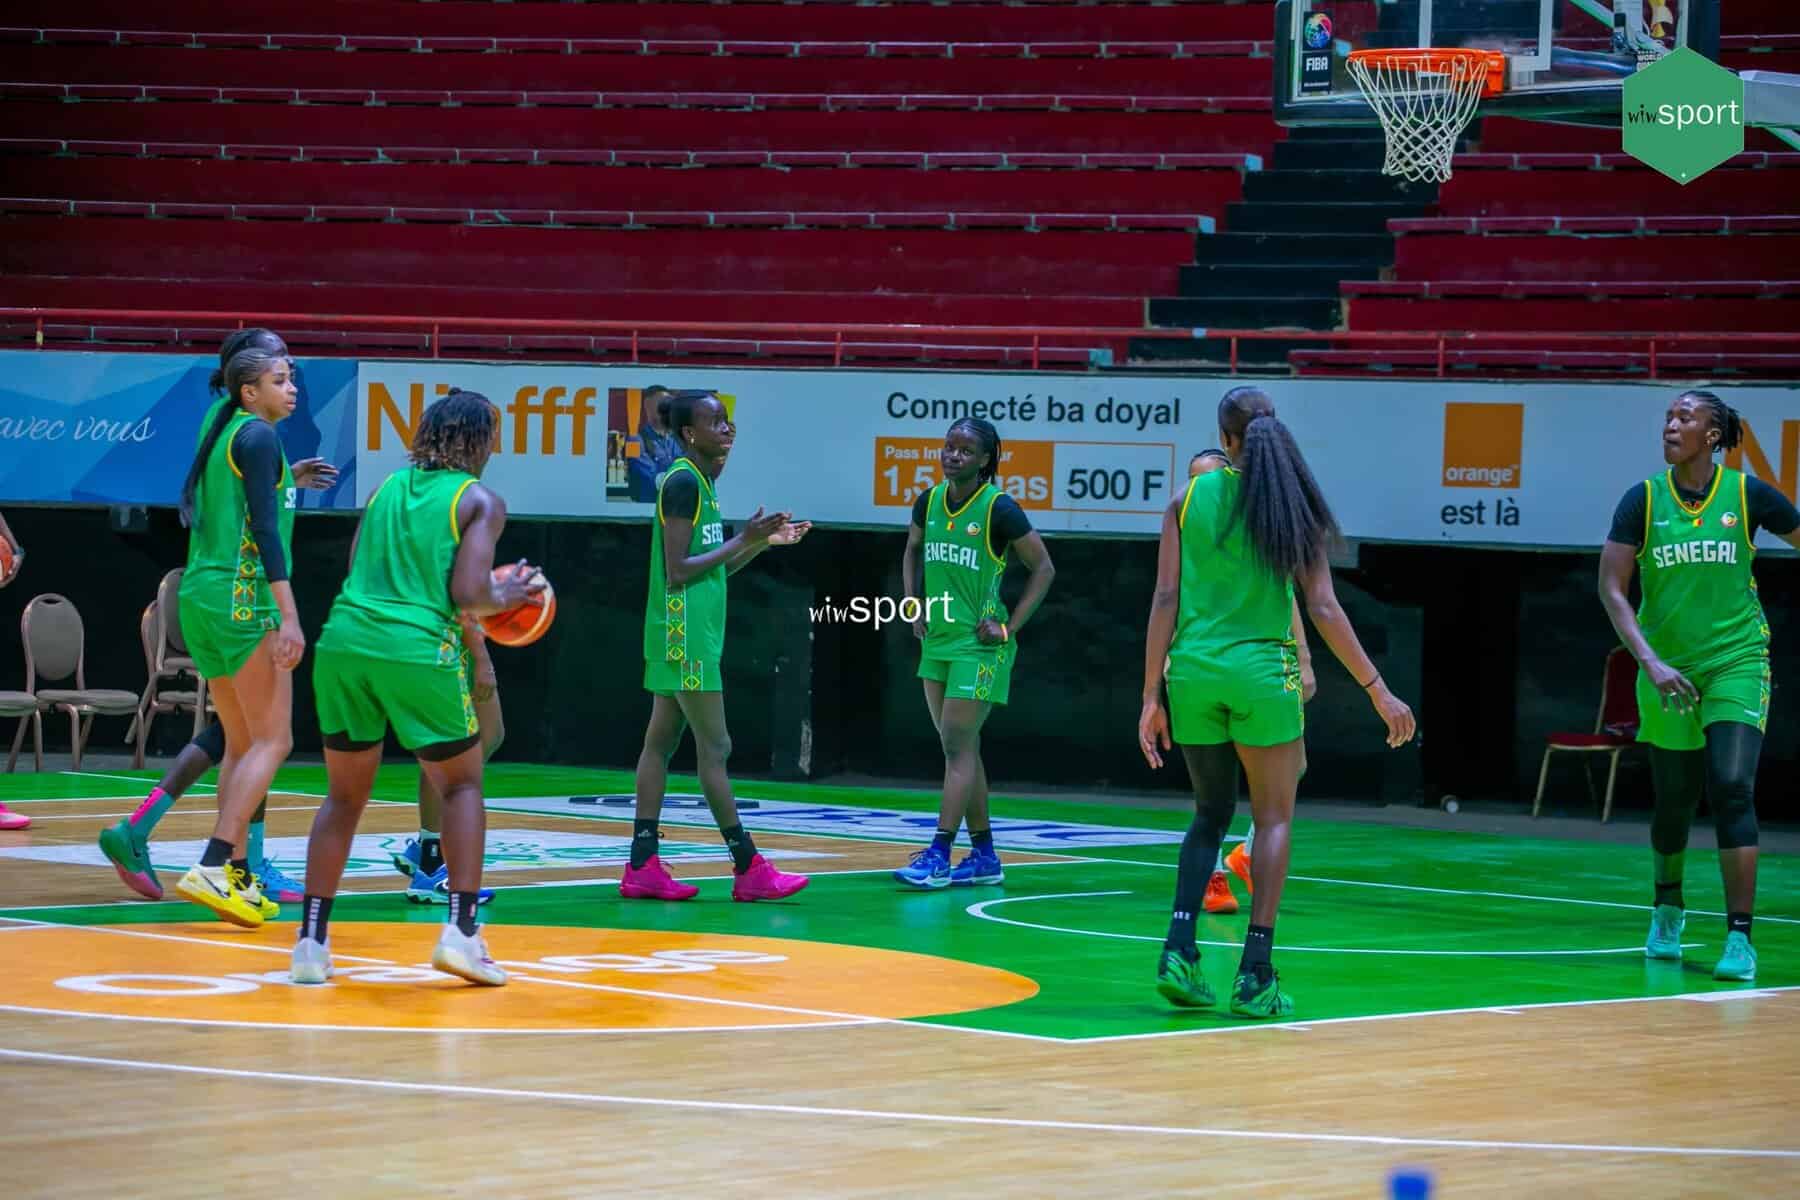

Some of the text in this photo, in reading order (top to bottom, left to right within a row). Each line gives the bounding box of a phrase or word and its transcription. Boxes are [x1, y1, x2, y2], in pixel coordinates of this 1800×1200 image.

[1306, 56, 1329, 72] FIBA
[887, 391, 1181, 432] Connecté ba doyal
[0, 415, 156, 442] avec vous
[884, 444, 918, 459] Pass
[1067, 468, 1165, 501] 500 F
[1441, 496, 1520, 526] est là
[925, 542, 980, 571] ENEGAL
[1652, 540, 1737, 569] SENEGAL
